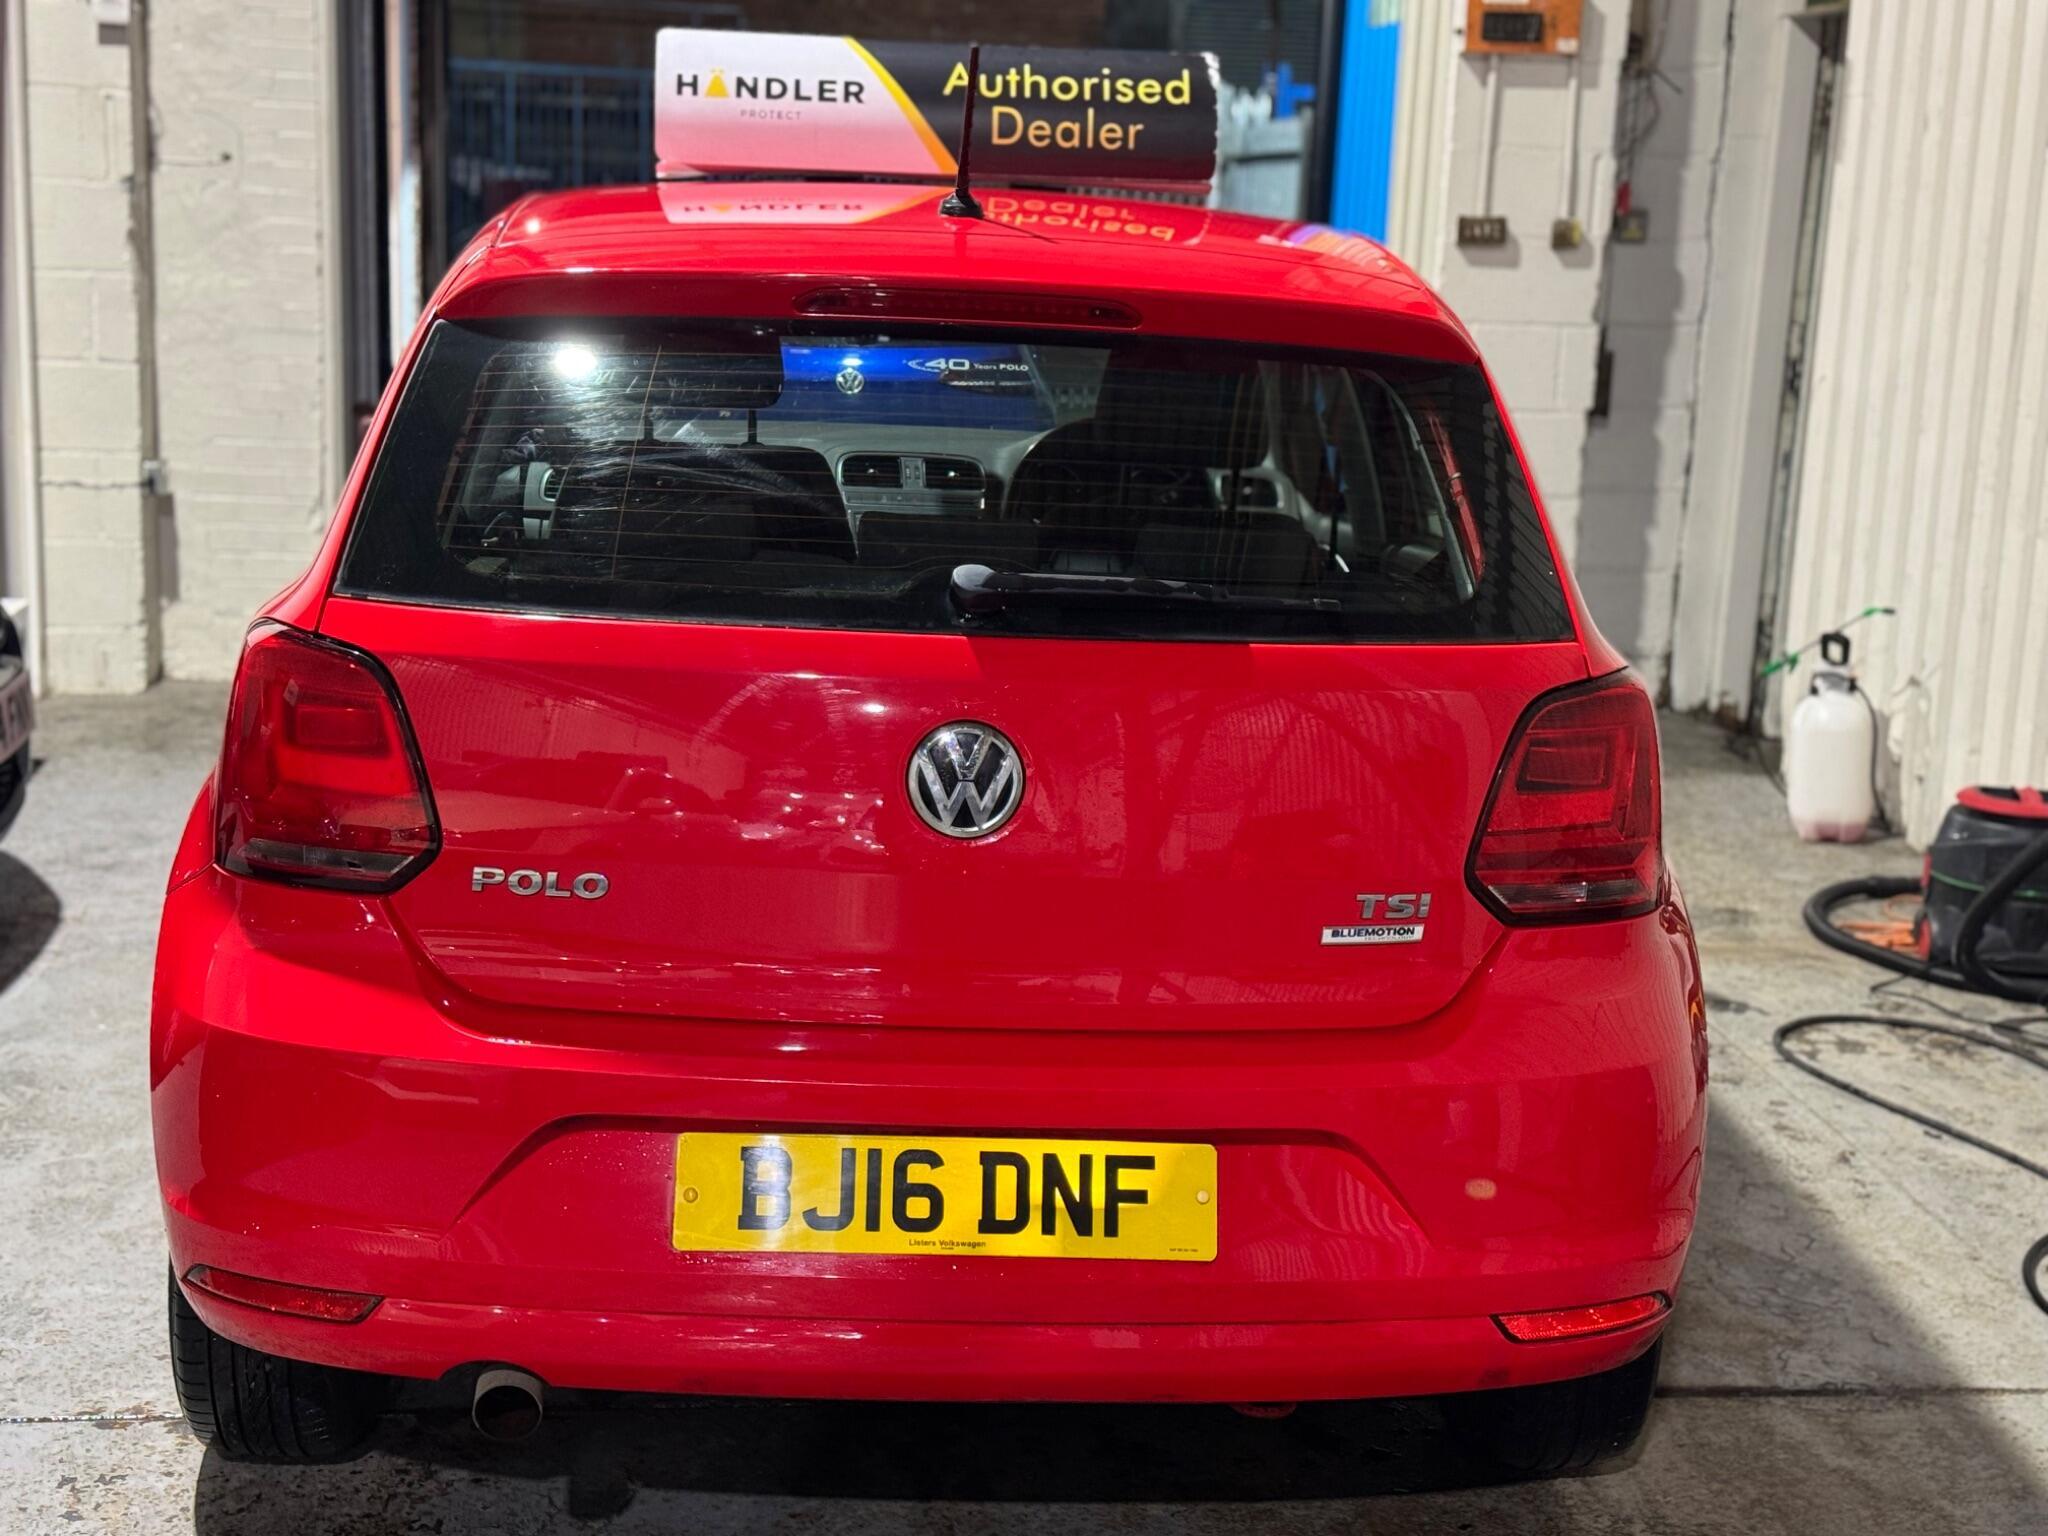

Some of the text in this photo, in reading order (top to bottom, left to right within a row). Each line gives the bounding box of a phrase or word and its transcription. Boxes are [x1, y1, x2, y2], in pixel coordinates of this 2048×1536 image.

[943, 61, 1191, 105] Authorised
[740, 108, 802, 121] PROTECT
[991, 105, 1144, 150] Dealer
[973, 362, 997, 370] Years
[999, 363, 1029, 371] POLO
[472, 866, 609, 899] POLO
[1356, 893, 1431, 919] TSI
[1331, 927, 1415, 938] BLUEMOTION
[738, 1145, 1156, 1238] BJ16 DNF
[908, 1239, 937, 1247] Listers
[938, 1240, 987, 1249] Volkswagen
